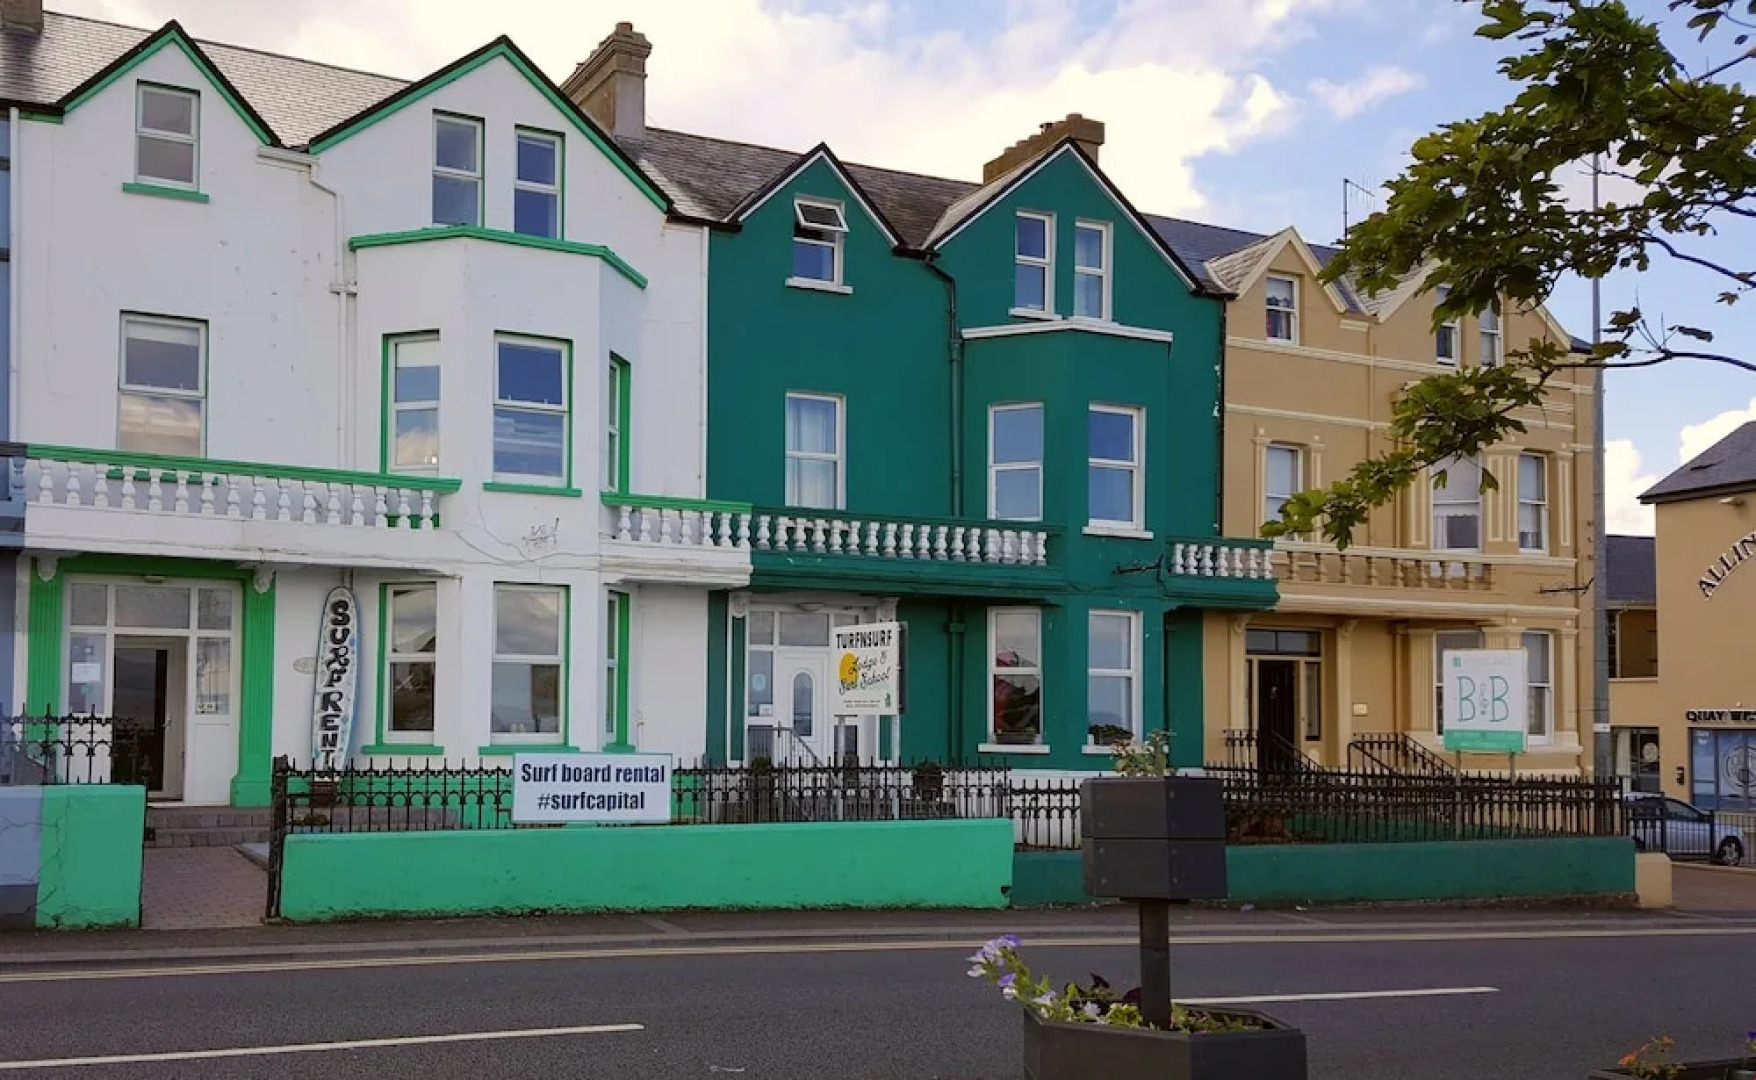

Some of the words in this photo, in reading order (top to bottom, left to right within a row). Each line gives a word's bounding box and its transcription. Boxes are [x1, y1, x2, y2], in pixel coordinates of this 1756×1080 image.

[836, 630, 892, 649] TURFNSURF
[1686, 710, 1725, 722] QUAY
[521, 763, 558, 783] Surf
[561, 763, 612, 783] board
[615, 764, 665, 783] rental
[537, 791, 645, 812] #surfcapital
